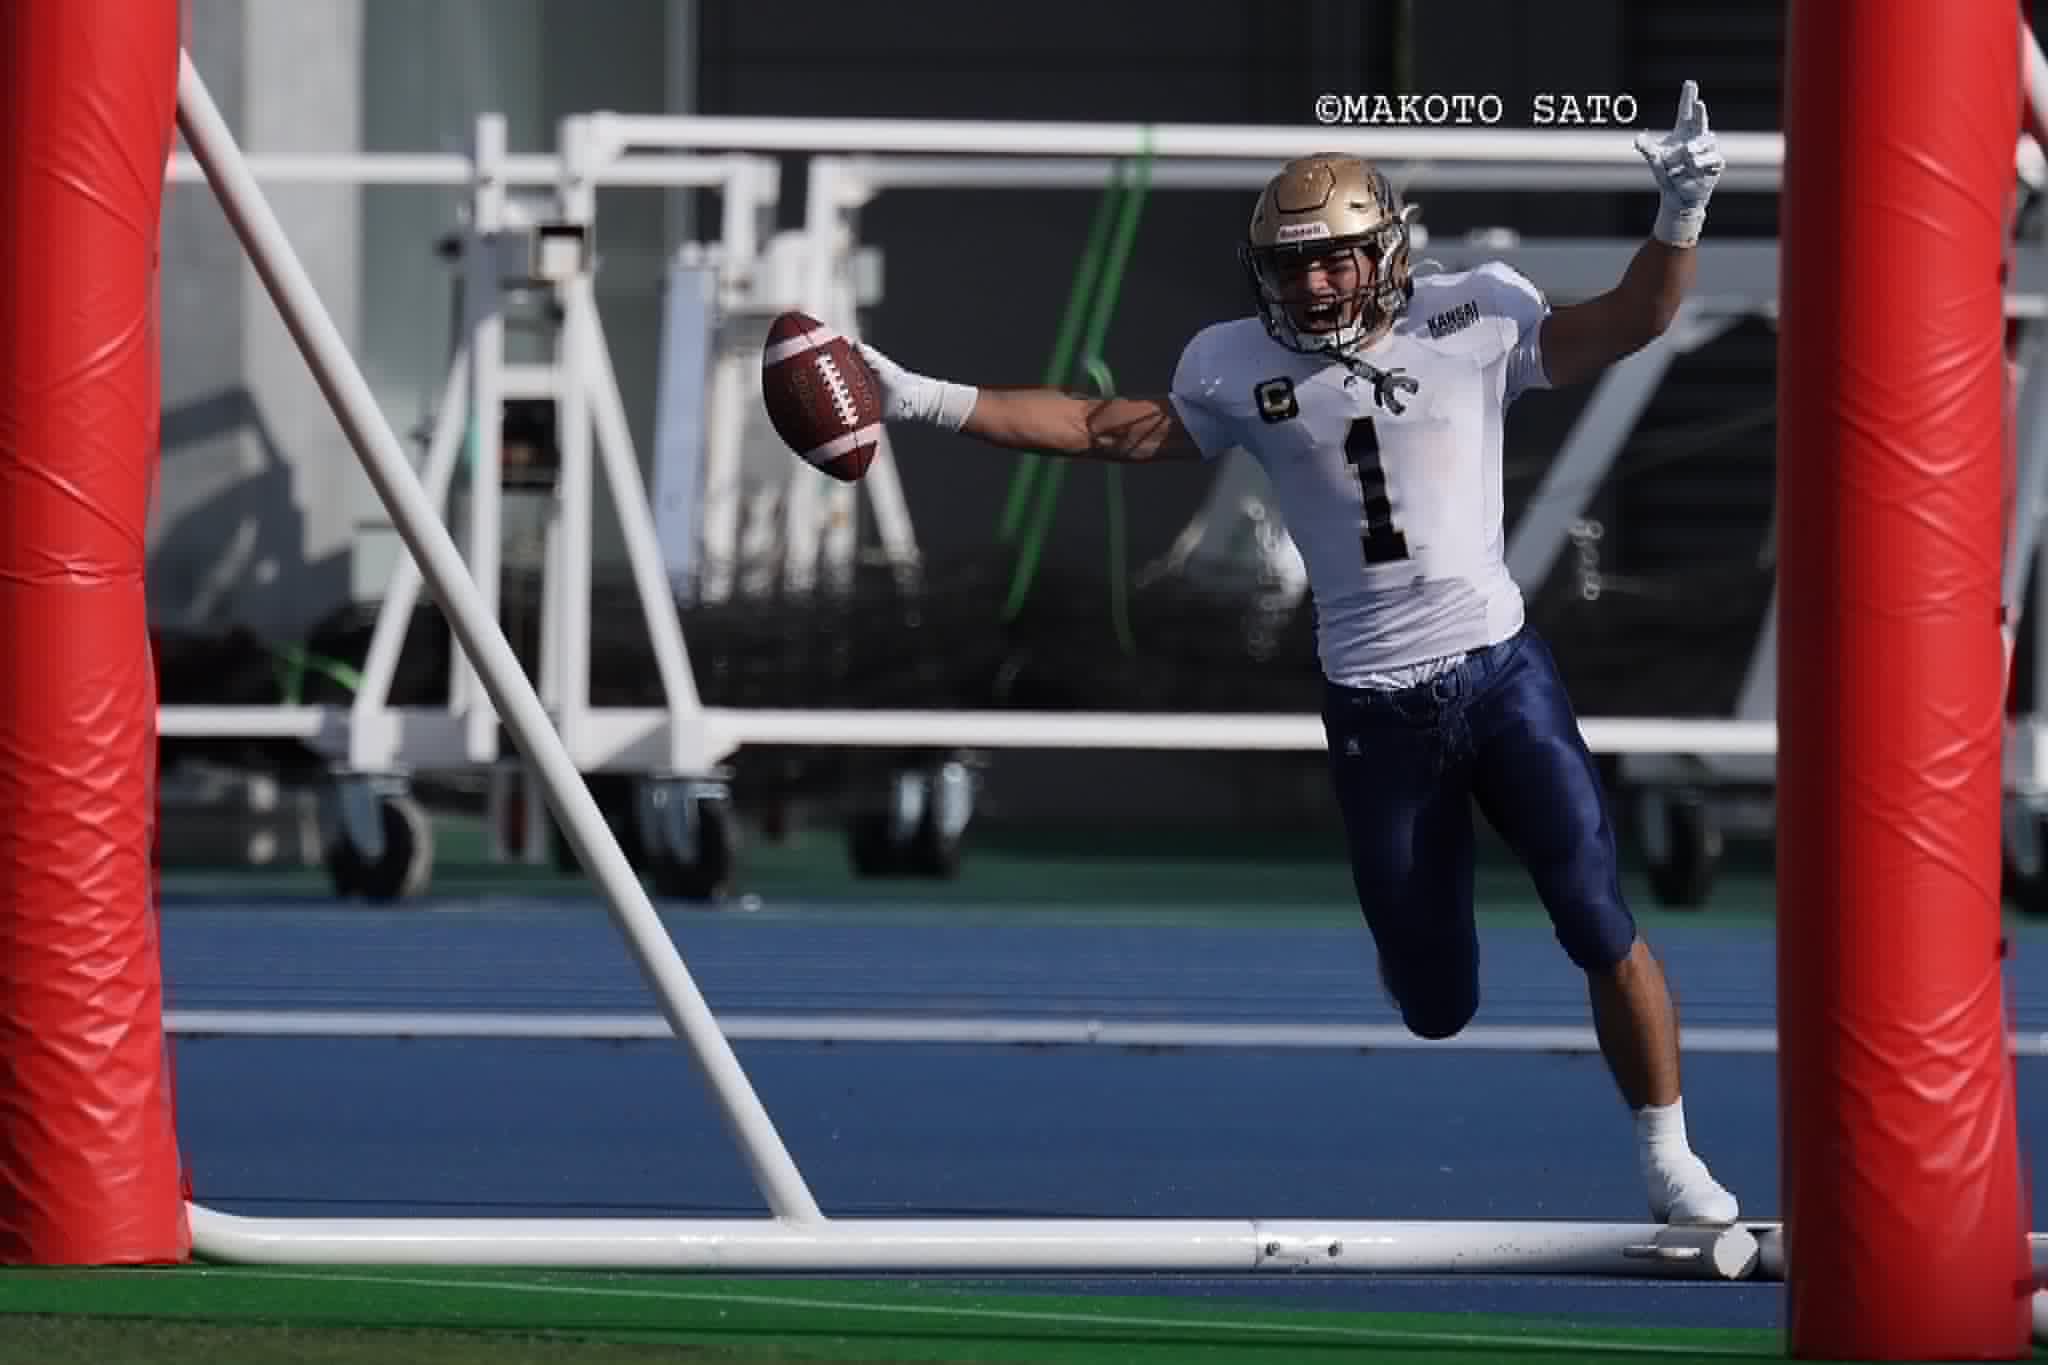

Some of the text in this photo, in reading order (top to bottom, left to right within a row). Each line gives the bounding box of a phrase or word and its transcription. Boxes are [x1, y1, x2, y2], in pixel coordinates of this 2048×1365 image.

[1427, 299, 1480, 331] KANSAI
[1262, 382, 1291, 412] C
[1344, 416, 1410, 564] 1
